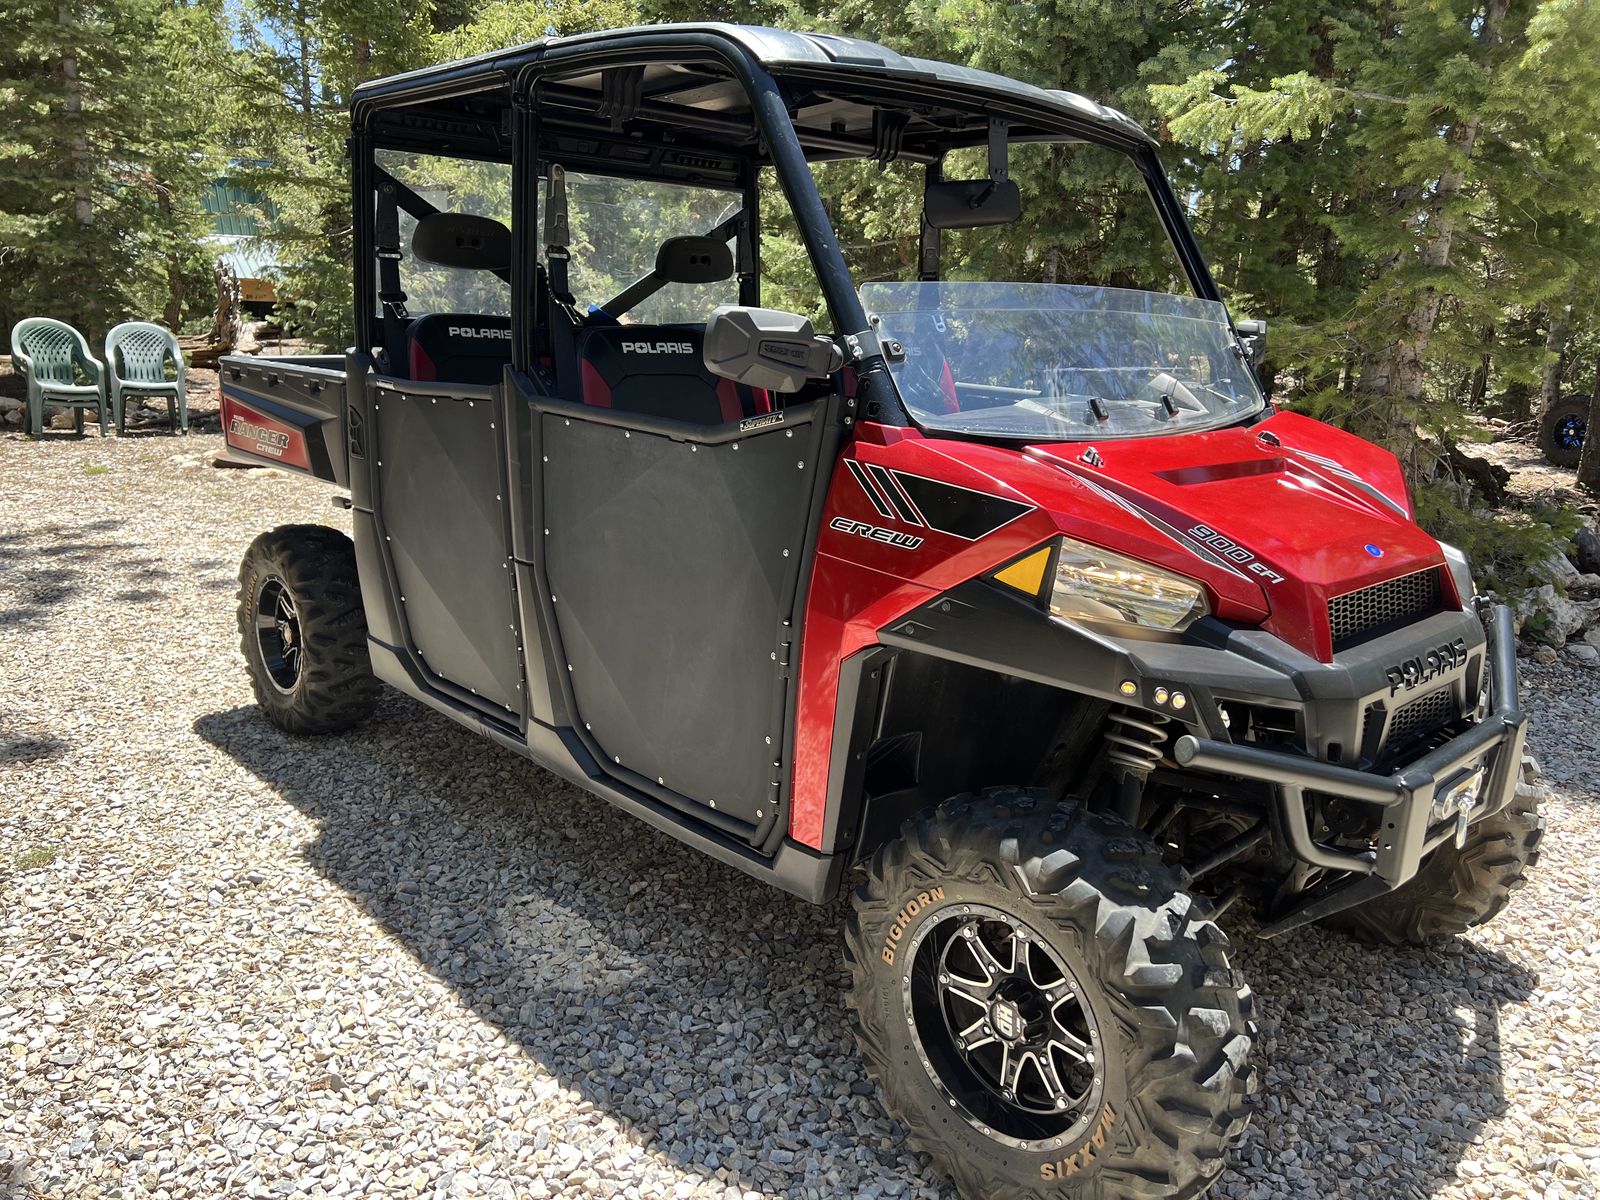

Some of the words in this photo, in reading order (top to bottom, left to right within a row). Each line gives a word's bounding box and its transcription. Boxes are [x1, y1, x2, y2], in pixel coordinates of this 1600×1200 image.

[448, 326, 512, 340] POLARIS
[621, 342, 694, 354] POLARIS
[230, 418, 290, 448] RANGER
[256, 442, 282, 456] CREW
[829, 516, 924, 550] CREW
[1188, 524, 1255, 563] 900
[1385, 637, 1468, 698] POLARIS
[881, 886, 945, 966] BIGHORN
[1040, 1102, 1116, 1181] MAXXIS
